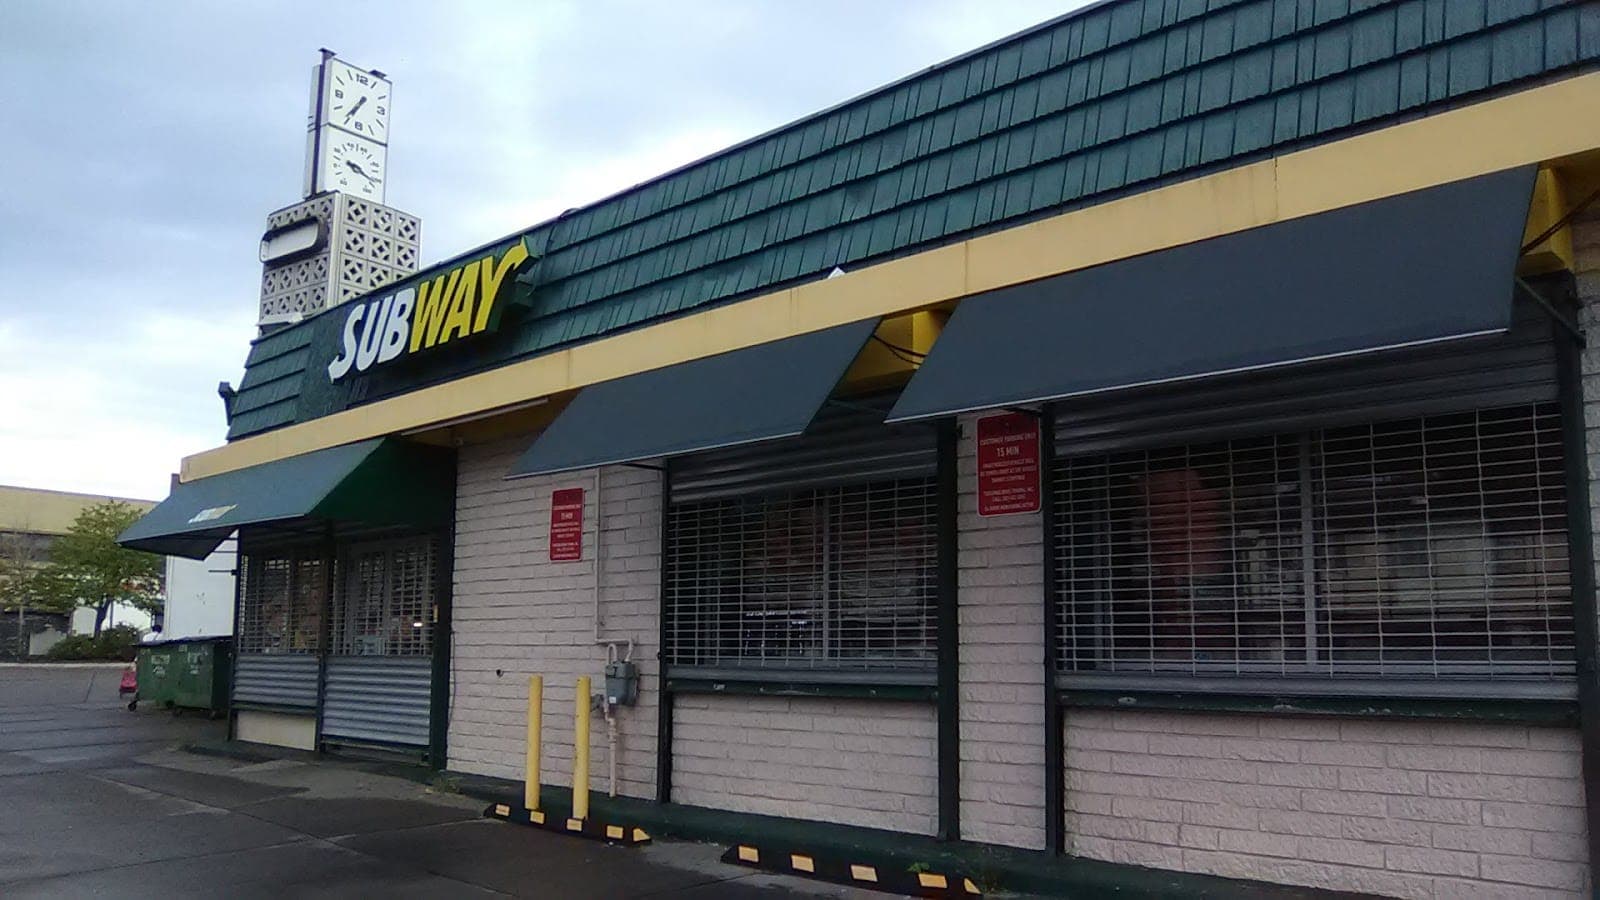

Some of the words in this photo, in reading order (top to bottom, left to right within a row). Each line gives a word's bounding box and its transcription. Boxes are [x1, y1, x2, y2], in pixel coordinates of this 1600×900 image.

[356, 73, 368, 86] 12
[335, 89, 344, 99] 9
[377, 105, 386, 116] 3
[355, 121, 363, 131] 6
[327, 235, 530, 385] SUBWAY
[996, 447, 1005, 457] 15
[1005, 446, 1020, 456] MIN
